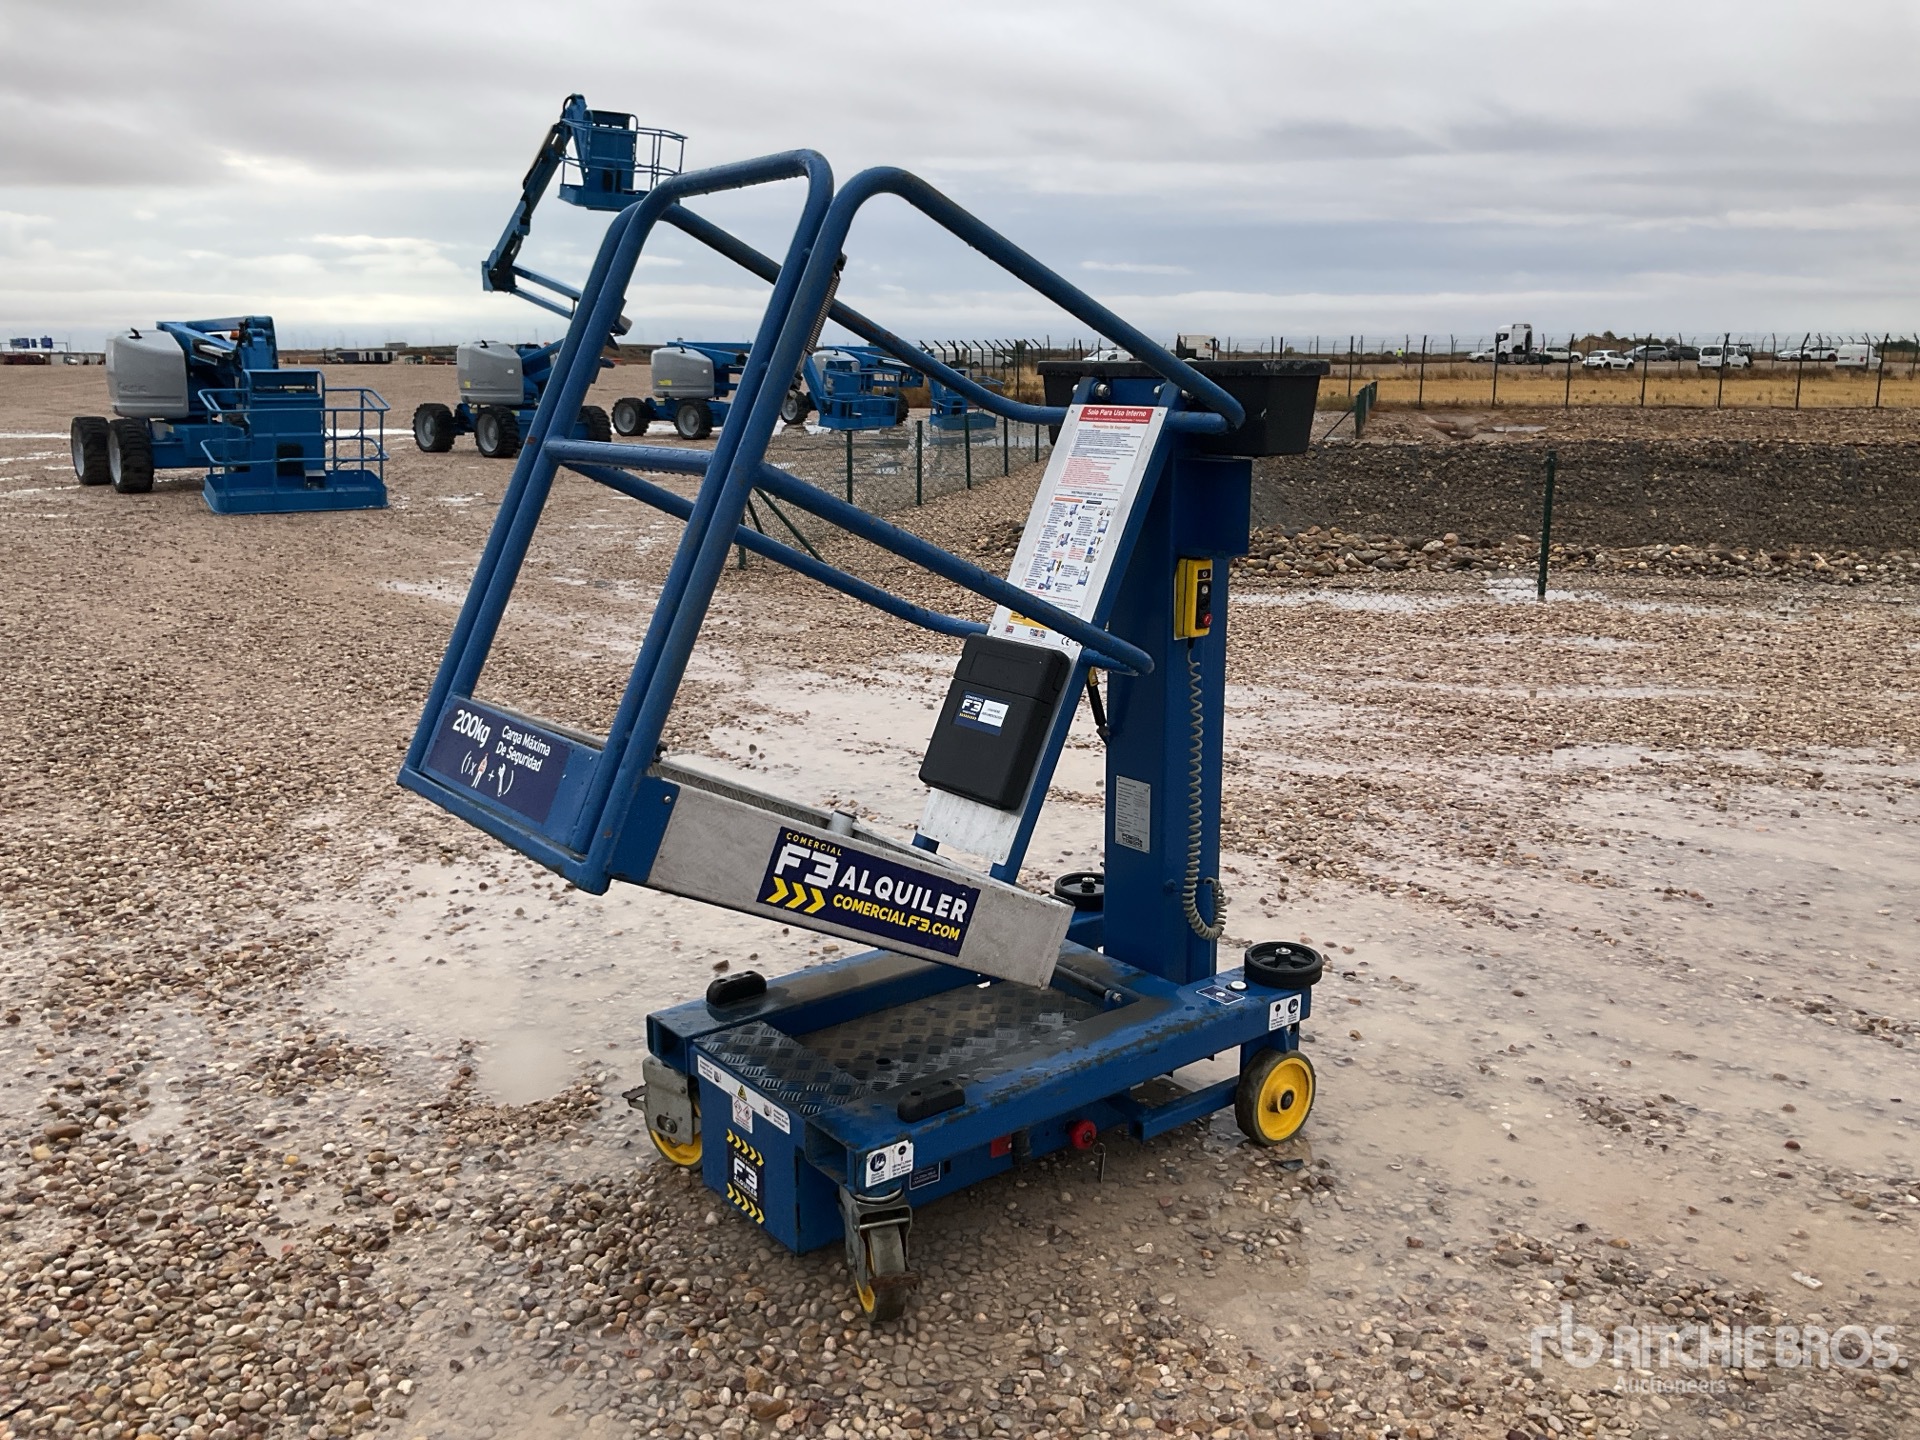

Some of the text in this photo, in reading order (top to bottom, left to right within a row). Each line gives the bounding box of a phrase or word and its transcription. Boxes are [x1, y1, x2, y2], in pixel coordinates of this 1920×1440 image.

[1087, 408, 1147, 418] Solo Para Uso Interno
[961, 698, 982, 713] F3
[452, 709, 491, 748] 200kg
[501, 725, 551, 757] Carga Máxima
[495, 741, 543, 772] De Seguridad
[786, 832, 842, 856] COMERCIAL
[774, 842, 968, 923] F3 ALQUILER
[832, 893, 961, 941] COMERCIALF3.COM
[734, 1157, 758, 1190] F3
